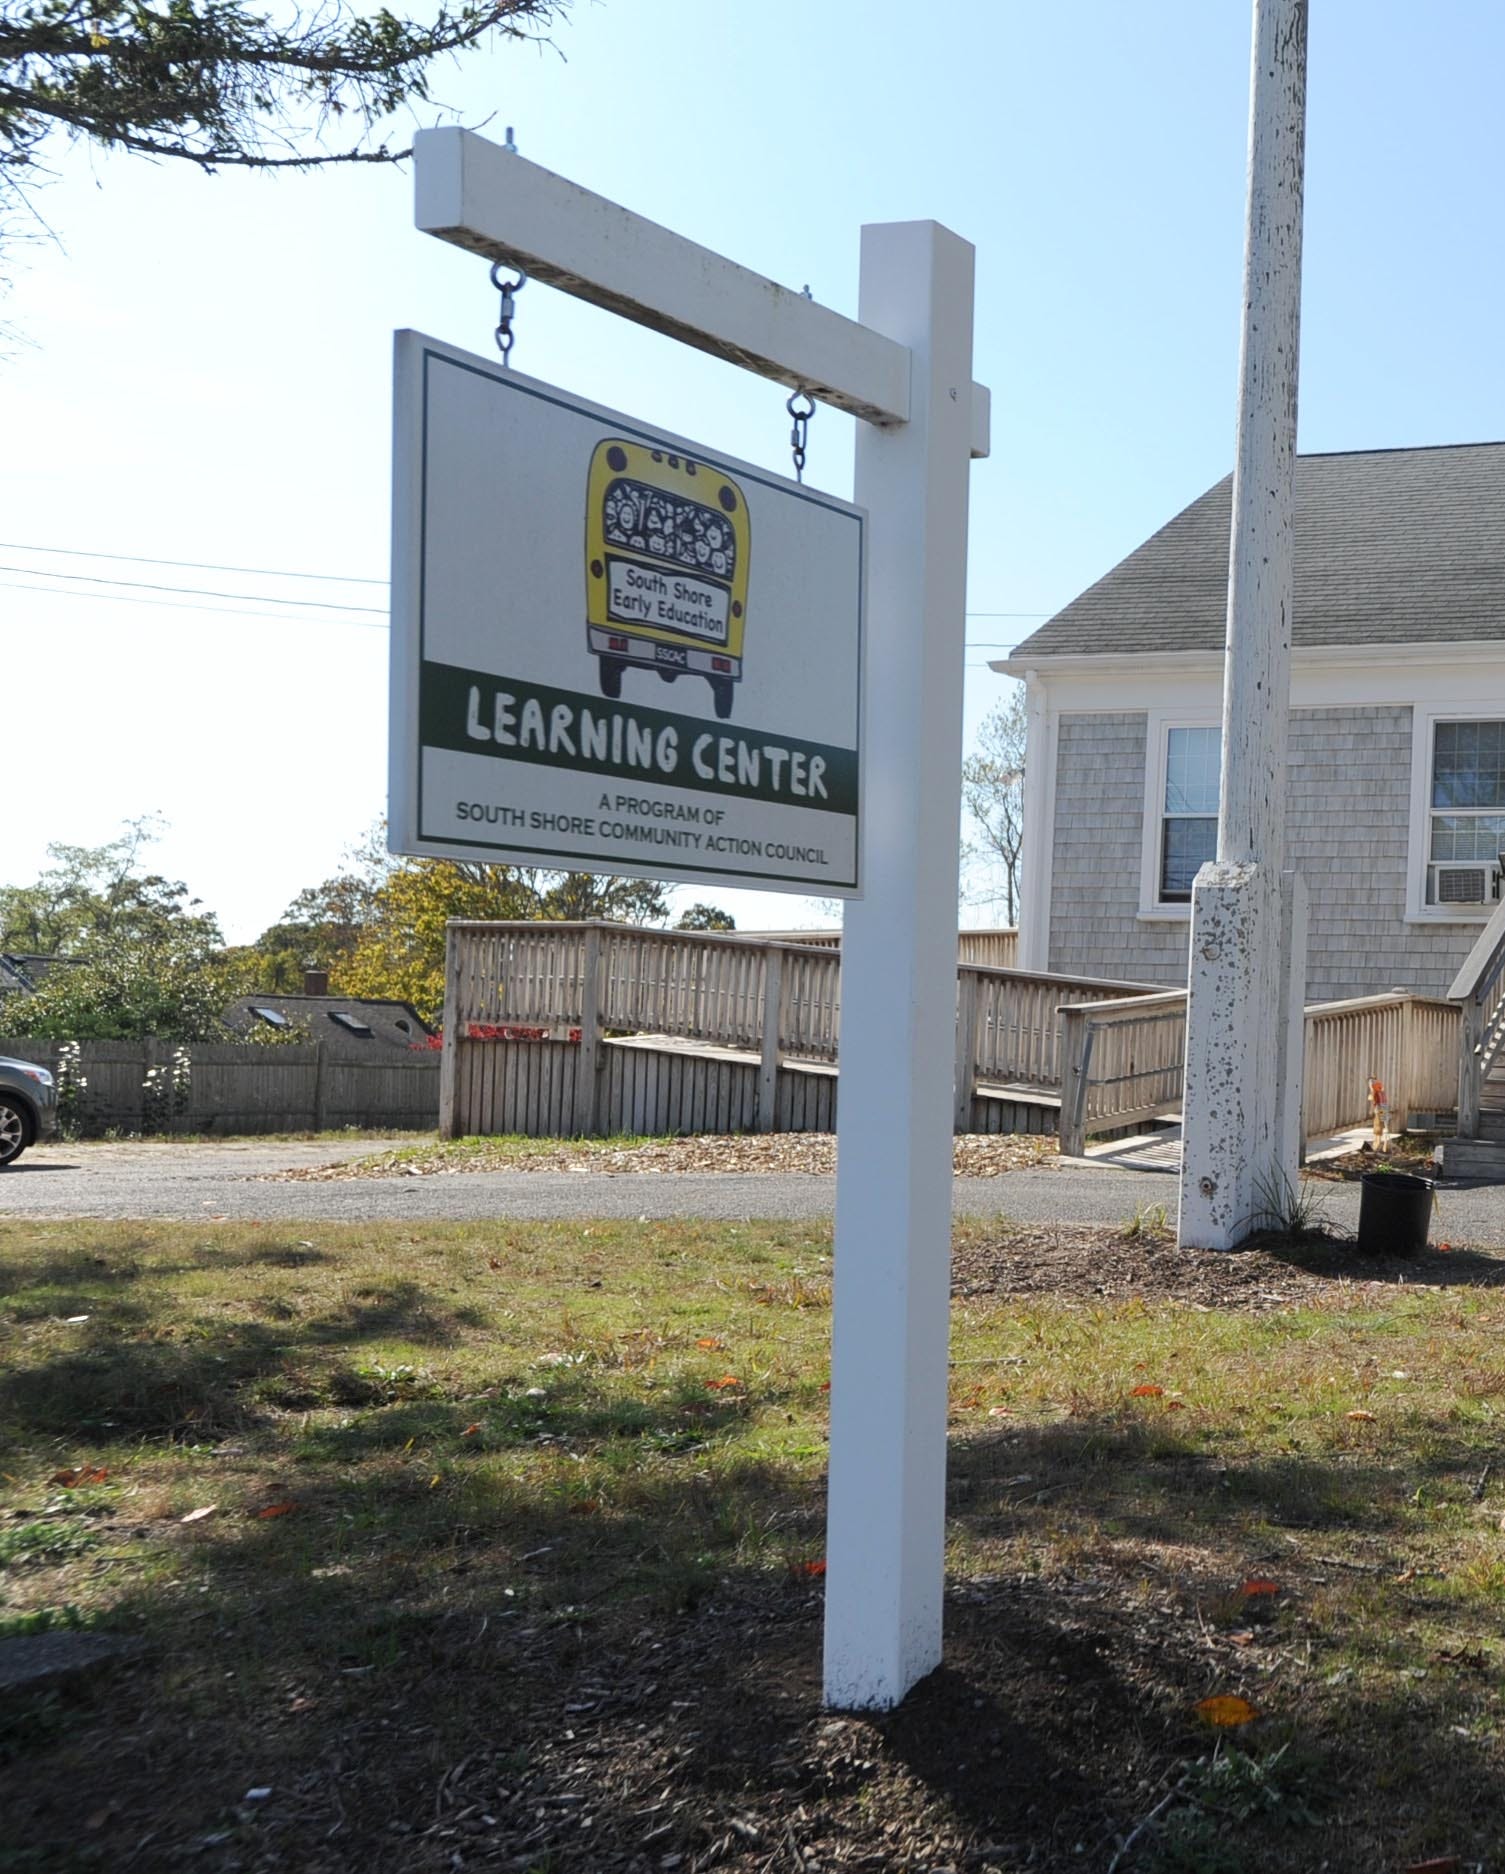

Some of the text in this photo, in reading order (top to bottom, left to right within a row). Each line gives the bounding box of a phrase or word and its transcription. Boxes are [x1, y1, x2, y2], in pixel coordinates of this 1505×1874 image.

[613, 588, 723, 633] Early Education
[626, 569, 712, 608] South Shore
[467, 685, 828, 799] LEARNING CENTER
[599, 793, 725, 826] A PROGRAM OF
[456, 802, 829, 865] SOUTH SHORE COMMUNITY ACTION COUNCIL
